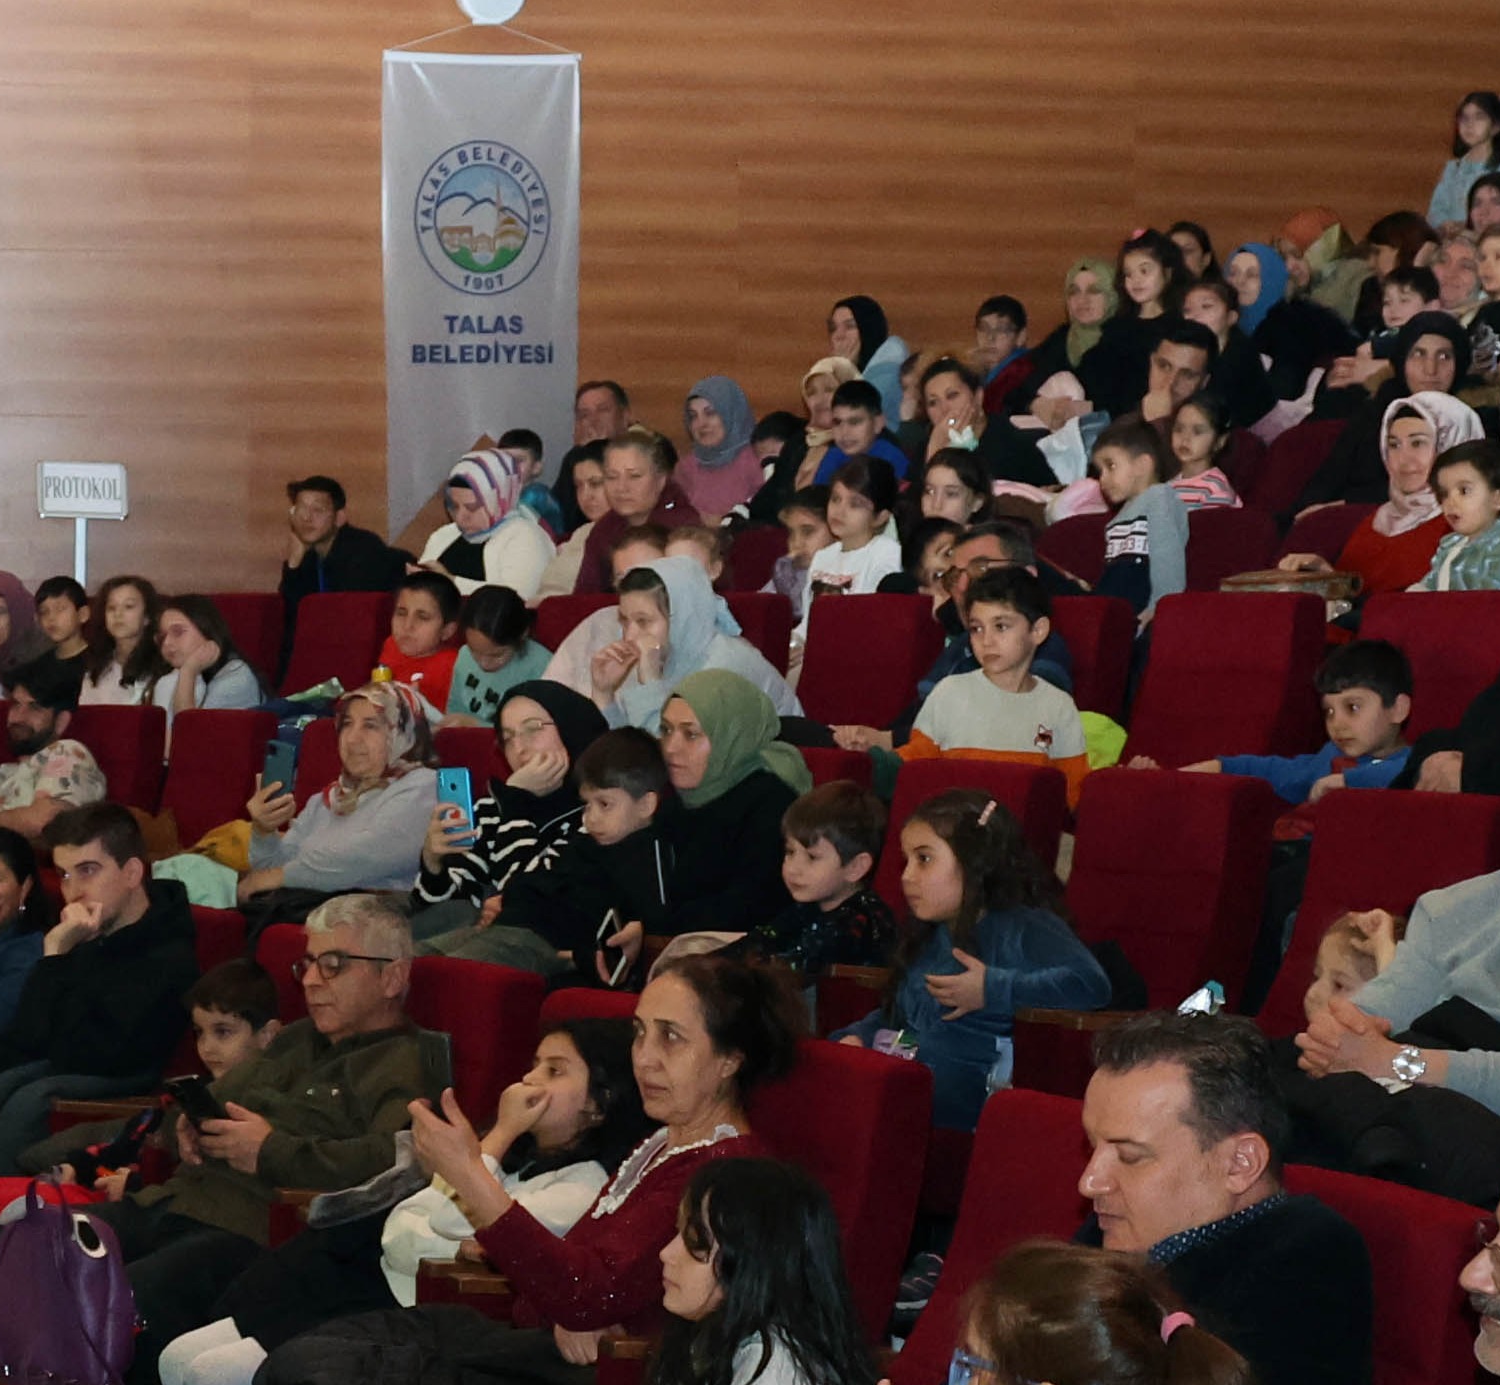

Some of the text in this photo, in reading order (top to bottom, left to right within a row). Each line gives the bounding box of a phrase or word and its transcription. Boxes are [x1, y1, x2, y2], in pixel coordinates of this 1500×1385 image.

[421, 163, 450, 233] TALAS
[463, 273, 504, 290] 1907
[444, 314, 524, 335] TALAS
[411, 340, 554, 365] BELEDİYESİ
[43, 475, 122, 501] PROTOKOL
